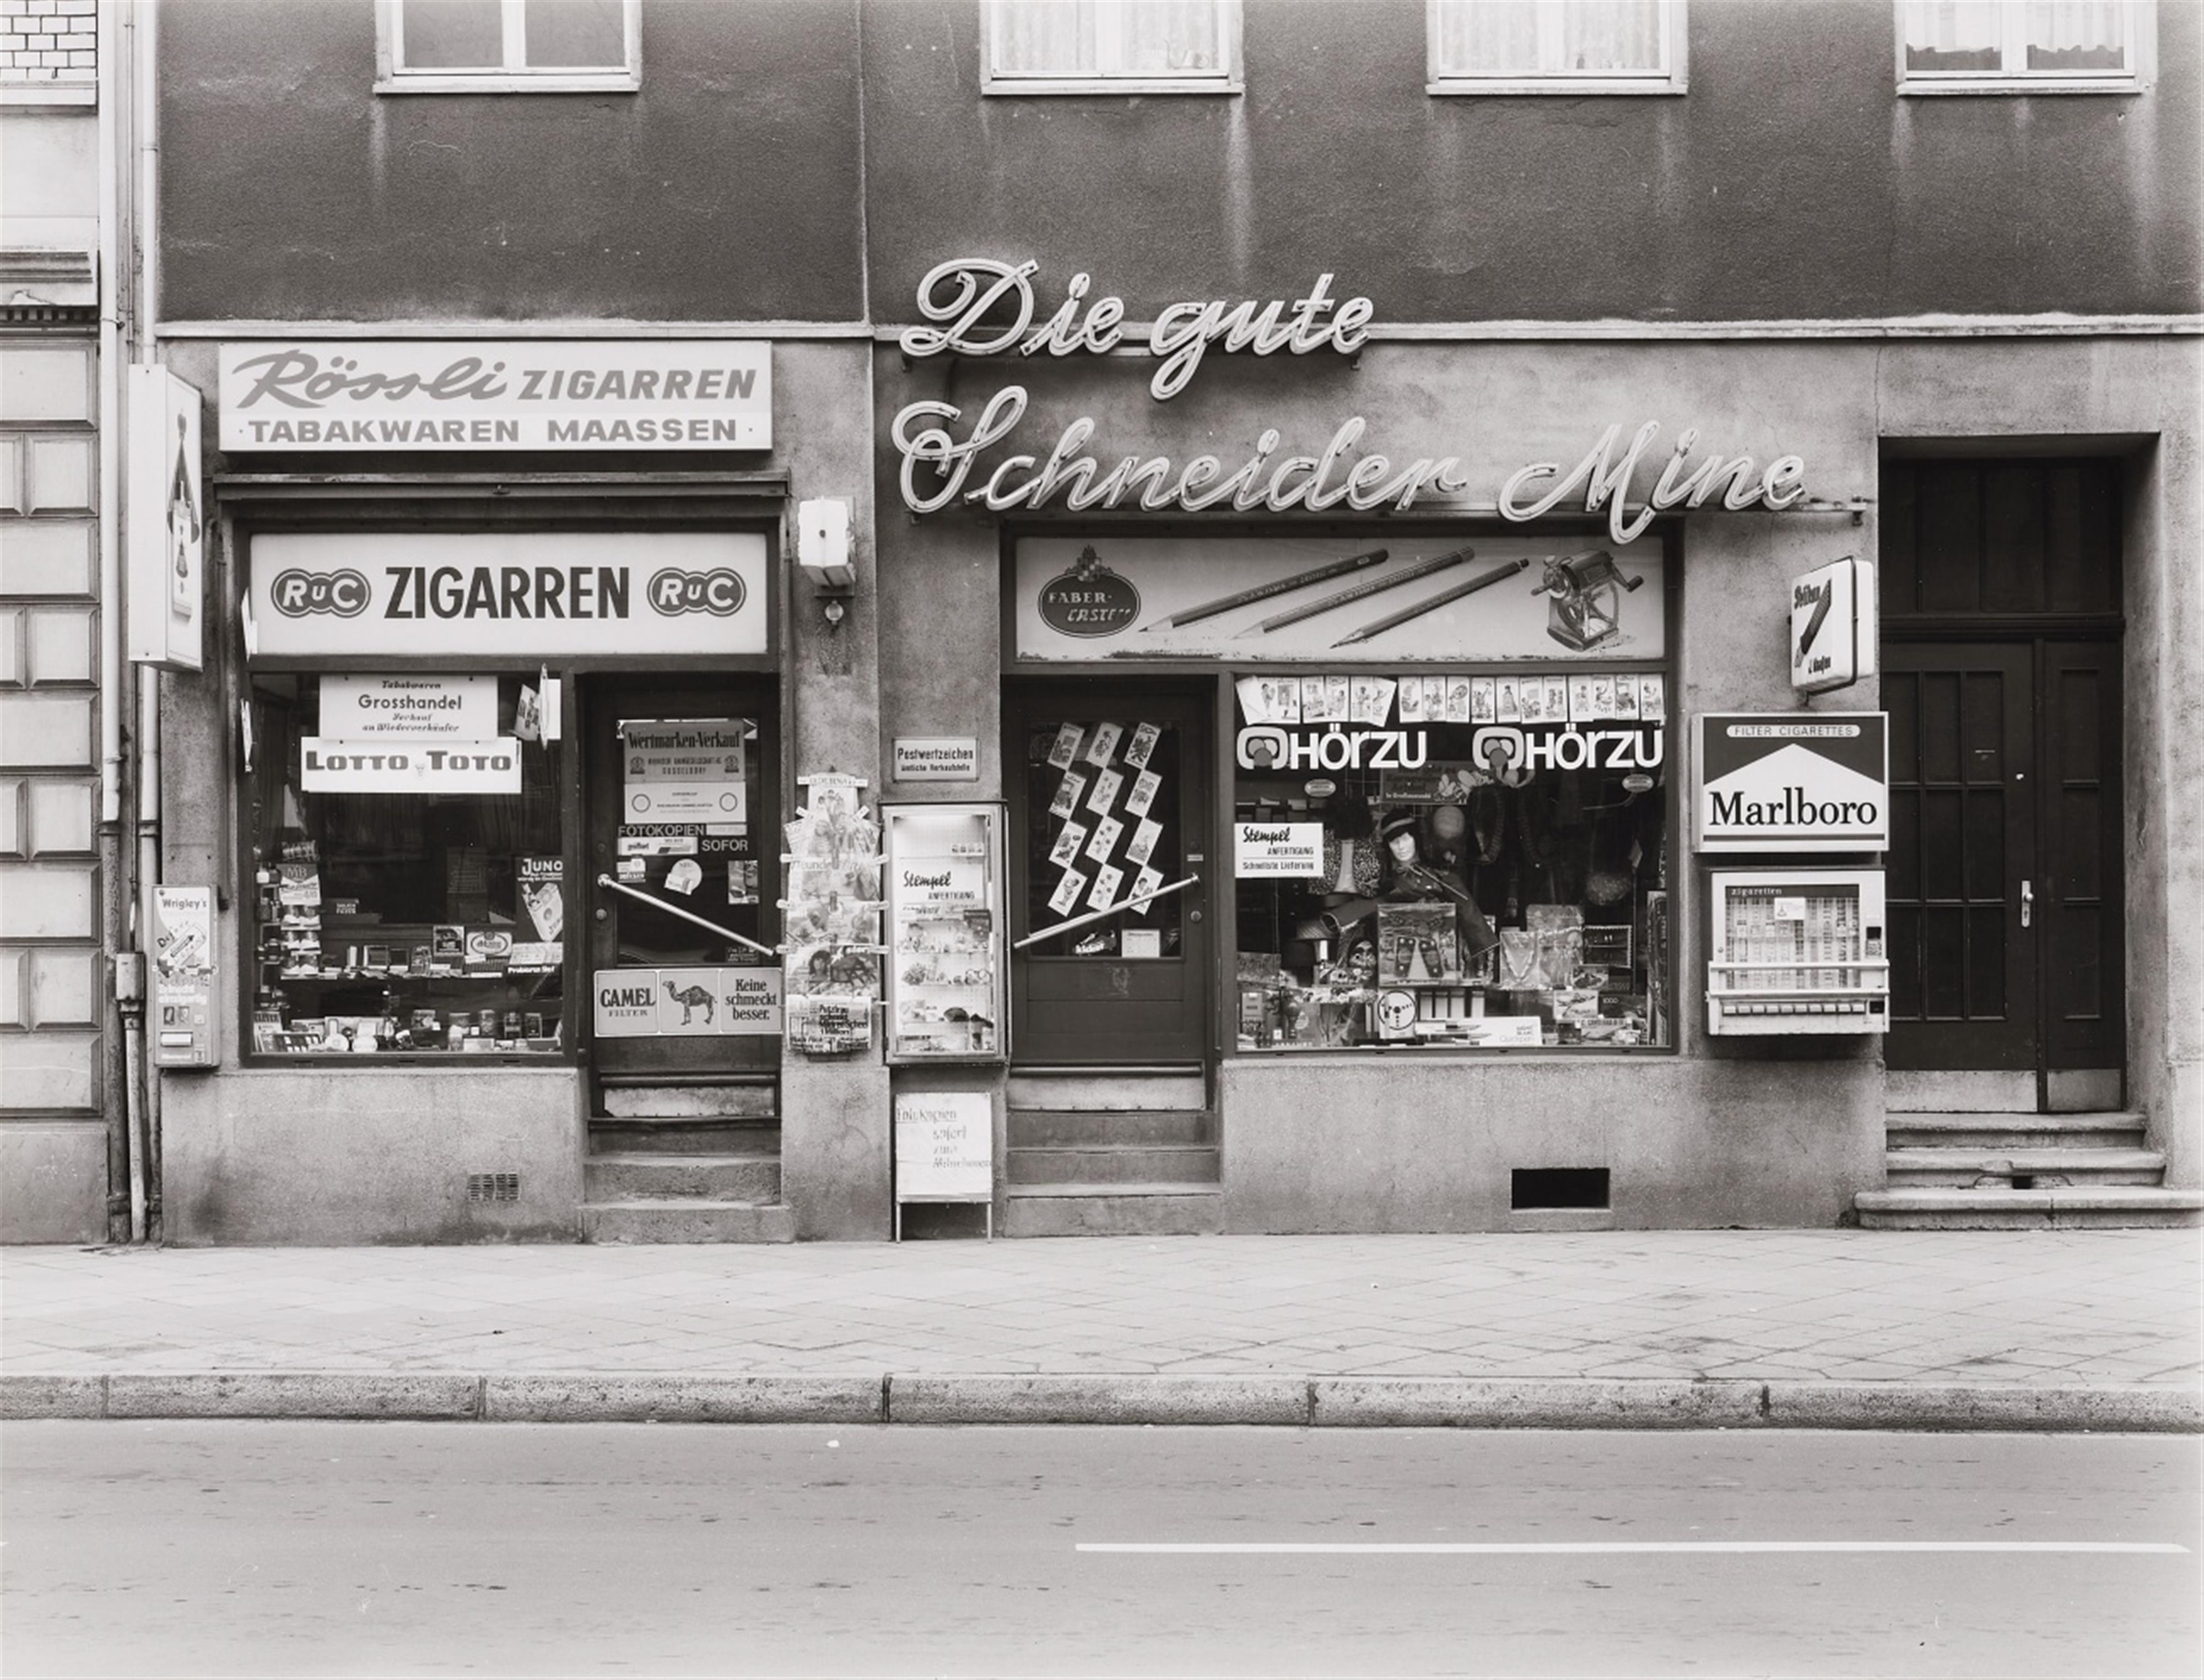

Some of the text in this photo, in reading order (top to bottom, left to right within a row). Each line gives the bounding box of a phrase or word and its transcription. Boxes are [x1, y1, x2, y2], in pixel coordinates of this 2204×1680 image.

[899, 258, 1374, 401] Die gute
[232, 349, 757, 409] Rössli ZIGARREN
[248, 418, 737, 443] TABAKWAREN MAASSEN
[892, 385, 1804, 545] Schneider Mine
[384, 566, 630, 620] ZIGARREN
[1049, 591, 1112, 604] FABER-
[381, 680, 441, 689] Tabakwaren
[358, 694, 462, 710] Grosshandel
[1735, 726, 1854, 736] FILTER CIGARETTES
[306, 750, 512, 771] LOTTO TOTO
[897, 747, 974, 760] Postwertzeichen
[1709, 786, 1878, 826] Marlboro
[618, 824, 704, 837] FOTOKOPIEN
[1243, 826, 1291, 846] Stempel
[1267, 846, 1314, 856] ANFERTIGUNG
[521, 857, 563, 876] JUNO
[903, 870, 952, 890] Stempel
[928, 891, 975, 900] ANFERTIGUNG
[1731, 888, 1782, 896] zigaretten
[162, 898, 207, 910] Wrigley's
[735, 979, 767, 992] Keine
[600, 987, 656, 1008] CAMEL
[725, 992, 777, 1006] schmeckt
[608, 1009, 648, 1018] FILTER
[732, 1007, 770, 1020] besser.
